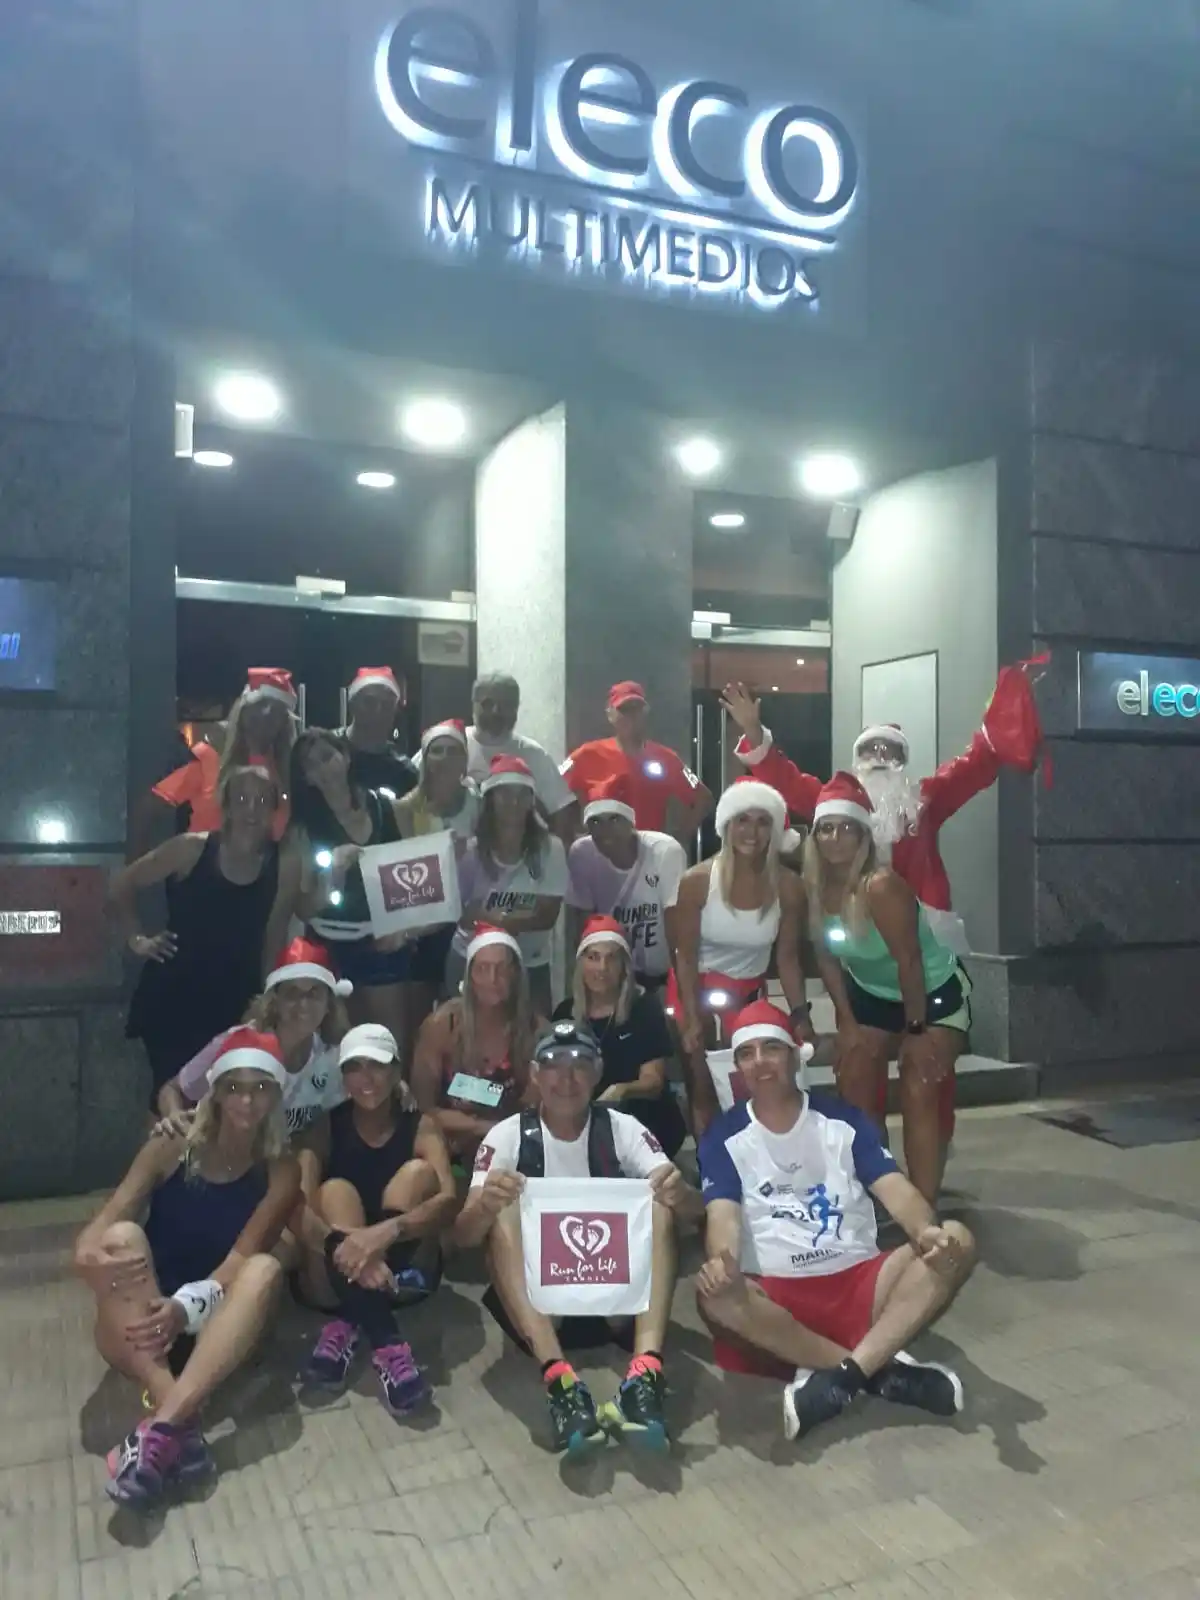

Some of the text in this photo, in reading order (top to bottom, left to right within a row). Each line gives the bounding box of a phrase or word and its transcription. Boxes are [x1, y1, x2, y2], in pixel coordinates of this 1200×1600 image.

[378, 0, 858, 226] eleco
[426, 176, 822, 303] MULTIMEDIOS
[1117, 670, 1200, 718] elec
[549, 1255, 618, 1278] Run for Life
